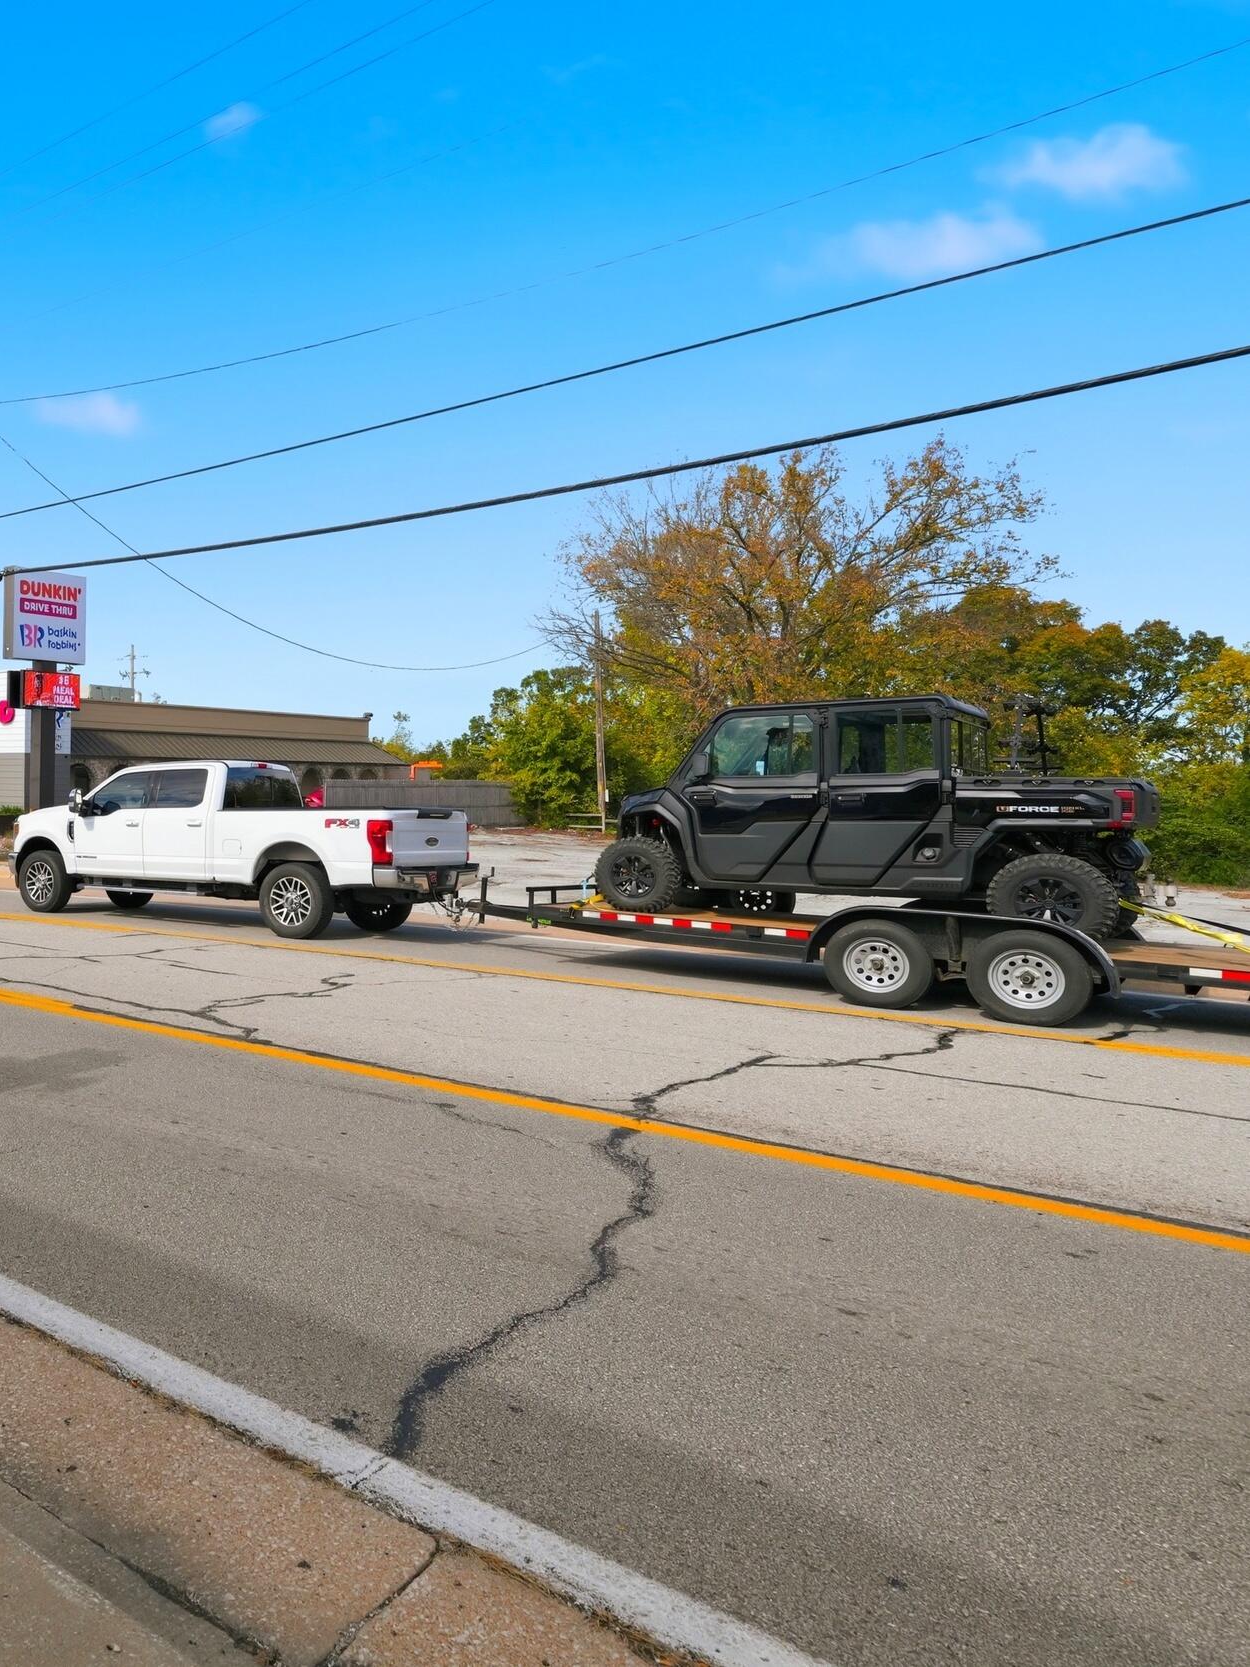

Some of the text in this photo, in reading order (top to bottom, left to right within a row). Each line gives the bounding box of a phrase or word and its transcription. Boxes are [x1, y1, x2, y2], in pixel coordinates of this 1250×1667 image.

[19, 579, 82, 602] DUNKIN'
[23, 601, 73, 616] DRIVE THRU
[19, 623, 45, 649] BR
[47, 626, 77, 640] baskin
[47, 639, 78, 652] robbins
[52, 685, 75, 696] MEAL
[53, 695, 75, 705] DEAL
[324, 818, 360, 829] FX4
